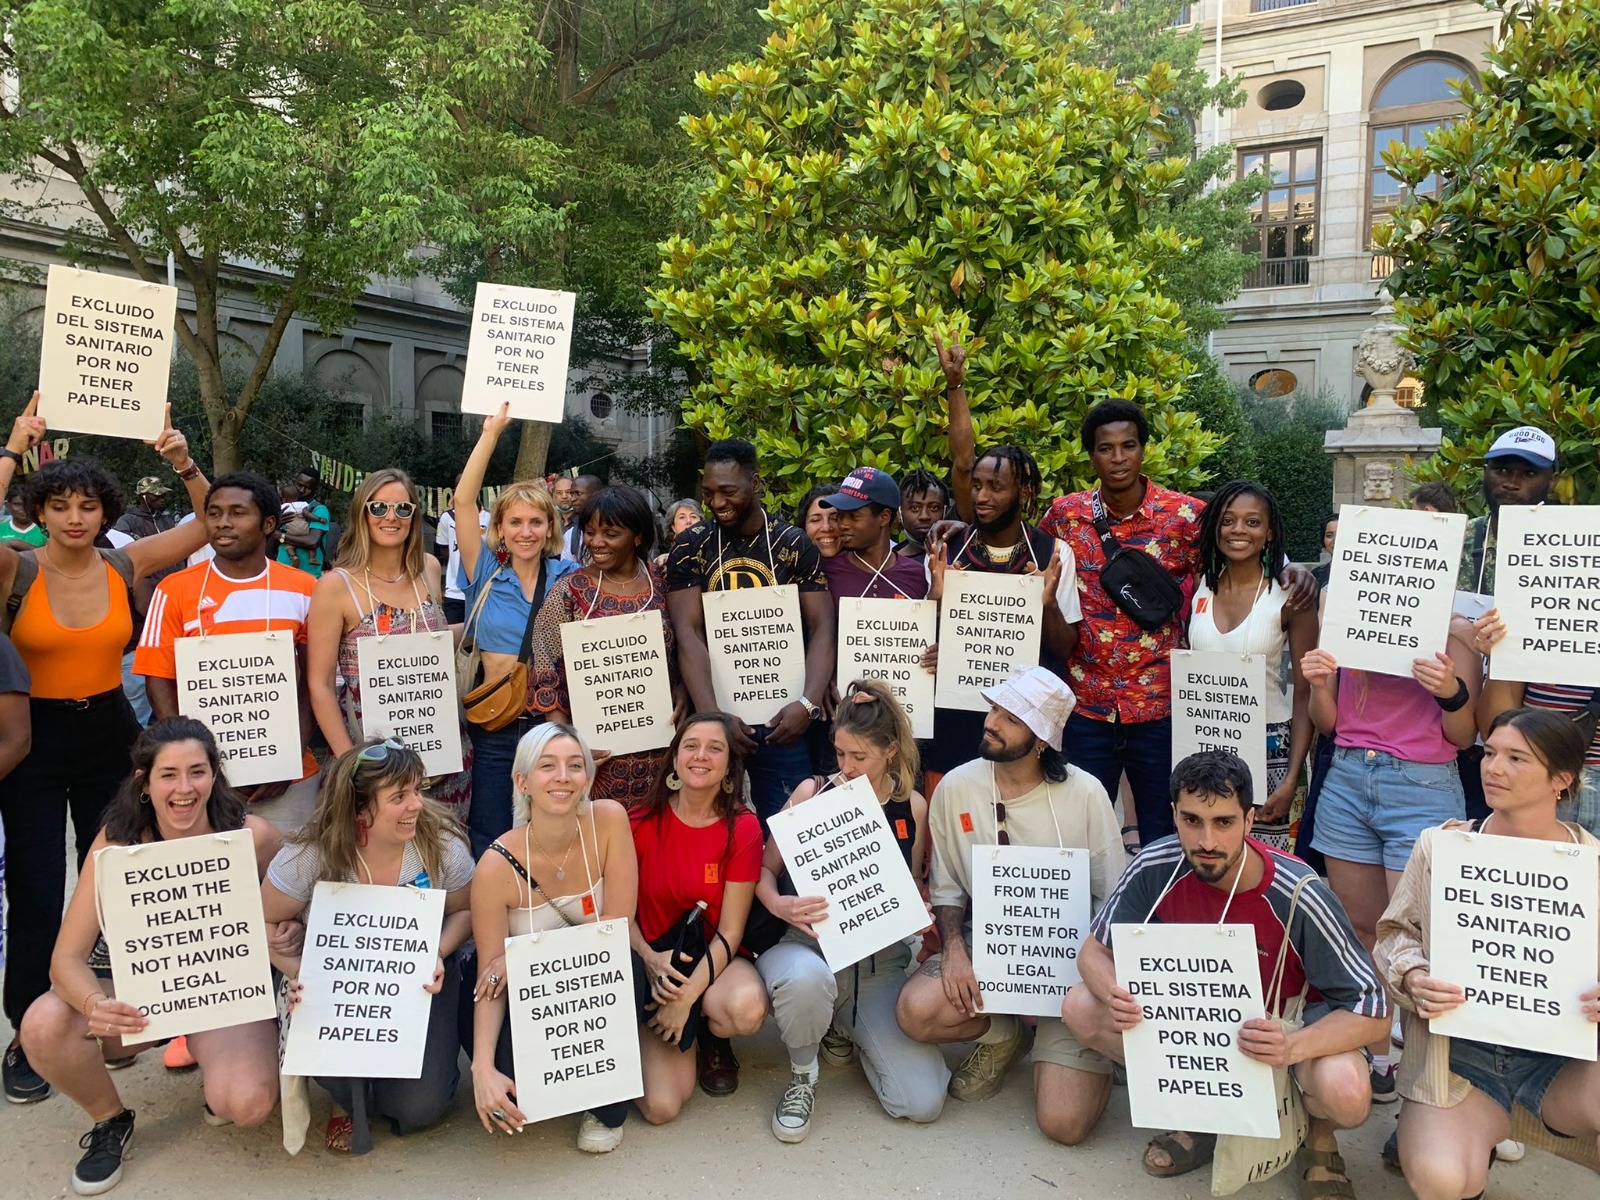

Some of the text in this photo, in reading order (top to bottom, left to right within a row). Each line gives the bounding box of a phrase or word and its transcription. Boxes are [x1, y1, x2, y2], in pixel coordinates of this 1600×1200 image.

[72, 295, 154, 320] EXCLUIDO
[493, 299, 557, 315] EXCLUIDO
[57, 312, 164, 341] DEL SISTEMA
[481, 313, 565, 331] DEL SISTEMA
[66, 334, 152, 357] SANITARIO
[487, 329, 555, 345] SANITARIO
[495, 345, 544, 360] POR NO
[76, 355, 139, 374] POR NO
[497, 361, 539, 375] TENER
[79, 374, 133, 392] TENER
[486, 376, 544, 391] PAPELES
[68, 392, 140, 411] PAPELES
[1358, 532, 1438, 551] EXCLUIDA
[1523, 533, 1600, 547] EXCLUID
[1342, 550, 1448, 572] DEL SISTEMA
[1508, 554, 1600, 568] DEL SISTE
[1349, 570, 1435, 590] SANITARIO
[1518, 575, 1600, 590] SANITAR
[960, 593, 1026, 607] EXCLUIDO
[1357, 590, 1420, 608] POR NO
[1531, 596, 1600, 612] POR NO
[722, 607, 784, 622] EXCLUIDO
[949, 609, 1034, 625] DEL SISTEMA
[1359, 609, 1412, 627] TENER
[714, 623, 795, 639] DEL SISTEMA
[857, 620, 919, 631] EXCLUIDA
[956, 626, 1025, 641] SANITARIO
[1535, 617, 1598, 633] TENER
[581, 634, 647, 653] EXCLUIDO
[846, 636, 928, 648] DEL SISTEMA
[1347, 627, 1419, 648] PAPELES
[724, 640, 788, 654] SANITARIO
[965, 643, 1014, 656] POR NO
[1522, 638, 1600, 655] PAPELE
[198, 656, 275, 672] EXCLUIDA
[378, 655, 439, 670] EXCLUIDO
[574, 650, 659, 671] DEL SISTEMA
[734, 656, 781, 670] POR NO
[853, 652, 920, 664] SANITARIO
[967, 659, 1009, 673] TENER
[187, 672, 287, 691] DEL SISTEMA
[369, 671, 449, 688] DEL SISTEMA
[584, 667, 653, 686] SANITARIO
[738, 673, 780, 685] TENER
[863, 669, 910, 680] POR NO
[1188, 673, 1248, 688] EXCLUIDA
[199, 691, 279, 708] SANITARIO
[378, 688, 443, 705] SANITARIO
[596, 684, 646, 701] POR NO
[733, 688, 788, 702] PAPELES
[1179, 689, 1258, 707] DEL SISTEMA
[211, 709, 270, 725] POR NO
[389, 706, 435, 721] POR NO
[601, 701, 644, 716] TENER
[1186, 707, 1251, 723] SANITARIO
[393, 723, 434, 737] TENER
[596, 716, 654, 734] PAPELES
[1195, 725, 1242, 740] POR NO
[216, 728, 267, 743] TENER
[219, 744, 277, 760] APELES
[796, 806, 865, 845] EXCLUIDA
[794, 820, 882, 867] DEL SISTEMA
[811, 839, 881, 881] SANITARIO
[124, 857, 230, 885] EXCLUDED
[828, 863, 879, 895] POR NO
[993, 866, 1071, 881] EXCLUDED
[1461, 865, 1568, 891] EXCLUIDO
[131, 879, 231, 907] FROM THE
[838, 883, 885, 911] TENER
[994, 885, 1069, 900] FROM THE
[1445, 887, 1585, 919] DEL SISTEMA
[146, 903, 222, 927] HEALTH
[838, 895, 899, 934] PAPELES
[1003, 905, 1060, 919] HEALTH
[333, 913, 419, 930] EXCLUIDA
[1457, 913, 1571, 941] SANITARIO
[125, 922, 250, 953] SYSTEM FOR
[985, 923, 1079, 940] SYSTEM FOR
[316, 934, 428, 953] DEL SISTEMA
[987, 943, 1076, 959] NOT HAVING
[1472, 939, 1554, 964] POR NO
[131, 944, 249, 975] NOT HAVING
[323, 957, 415, 974] SANITARIO
[530, 951, 610, 977] EXCLUIDO
[1140, 958, 1233, 973] EXCLUIDA
[1007, 964, 1056, 978] LEGAL
[1477, 964, 1548, 989] TENER
[162, 971, 226, 993] LEGAL
[332, 980, 400, 996] POR NO
[519, 970, 624, 1001] DEL SISTEMA
[978, 981, 1074, 996] DOCUMENTATI
[1128, 981, 1251, 999] DEL SISTEMA
[138, 984, 267, 1018] OCUMENTATION
[531, 993, 616, 1021] SANITARIO
[1465, 987, 1560, 1016] PAPELES
[334, 1004, 392, 1019] TENER
[1143, 1005, 1242, 1023] SANITARIO
[319, 1026, 398, 1043] PAPELES
[545, 1016, 607, 1040] POR NO
[1158, 1030, 1231, 1047] POR NO
[551, 1039, 605, 1061] TENER
[544, 1058, 616, 1085] PAPELES
[1165, 1054, 1229, 1072] TENER
[1158, 1078, 1243, 1098] PAPELES
